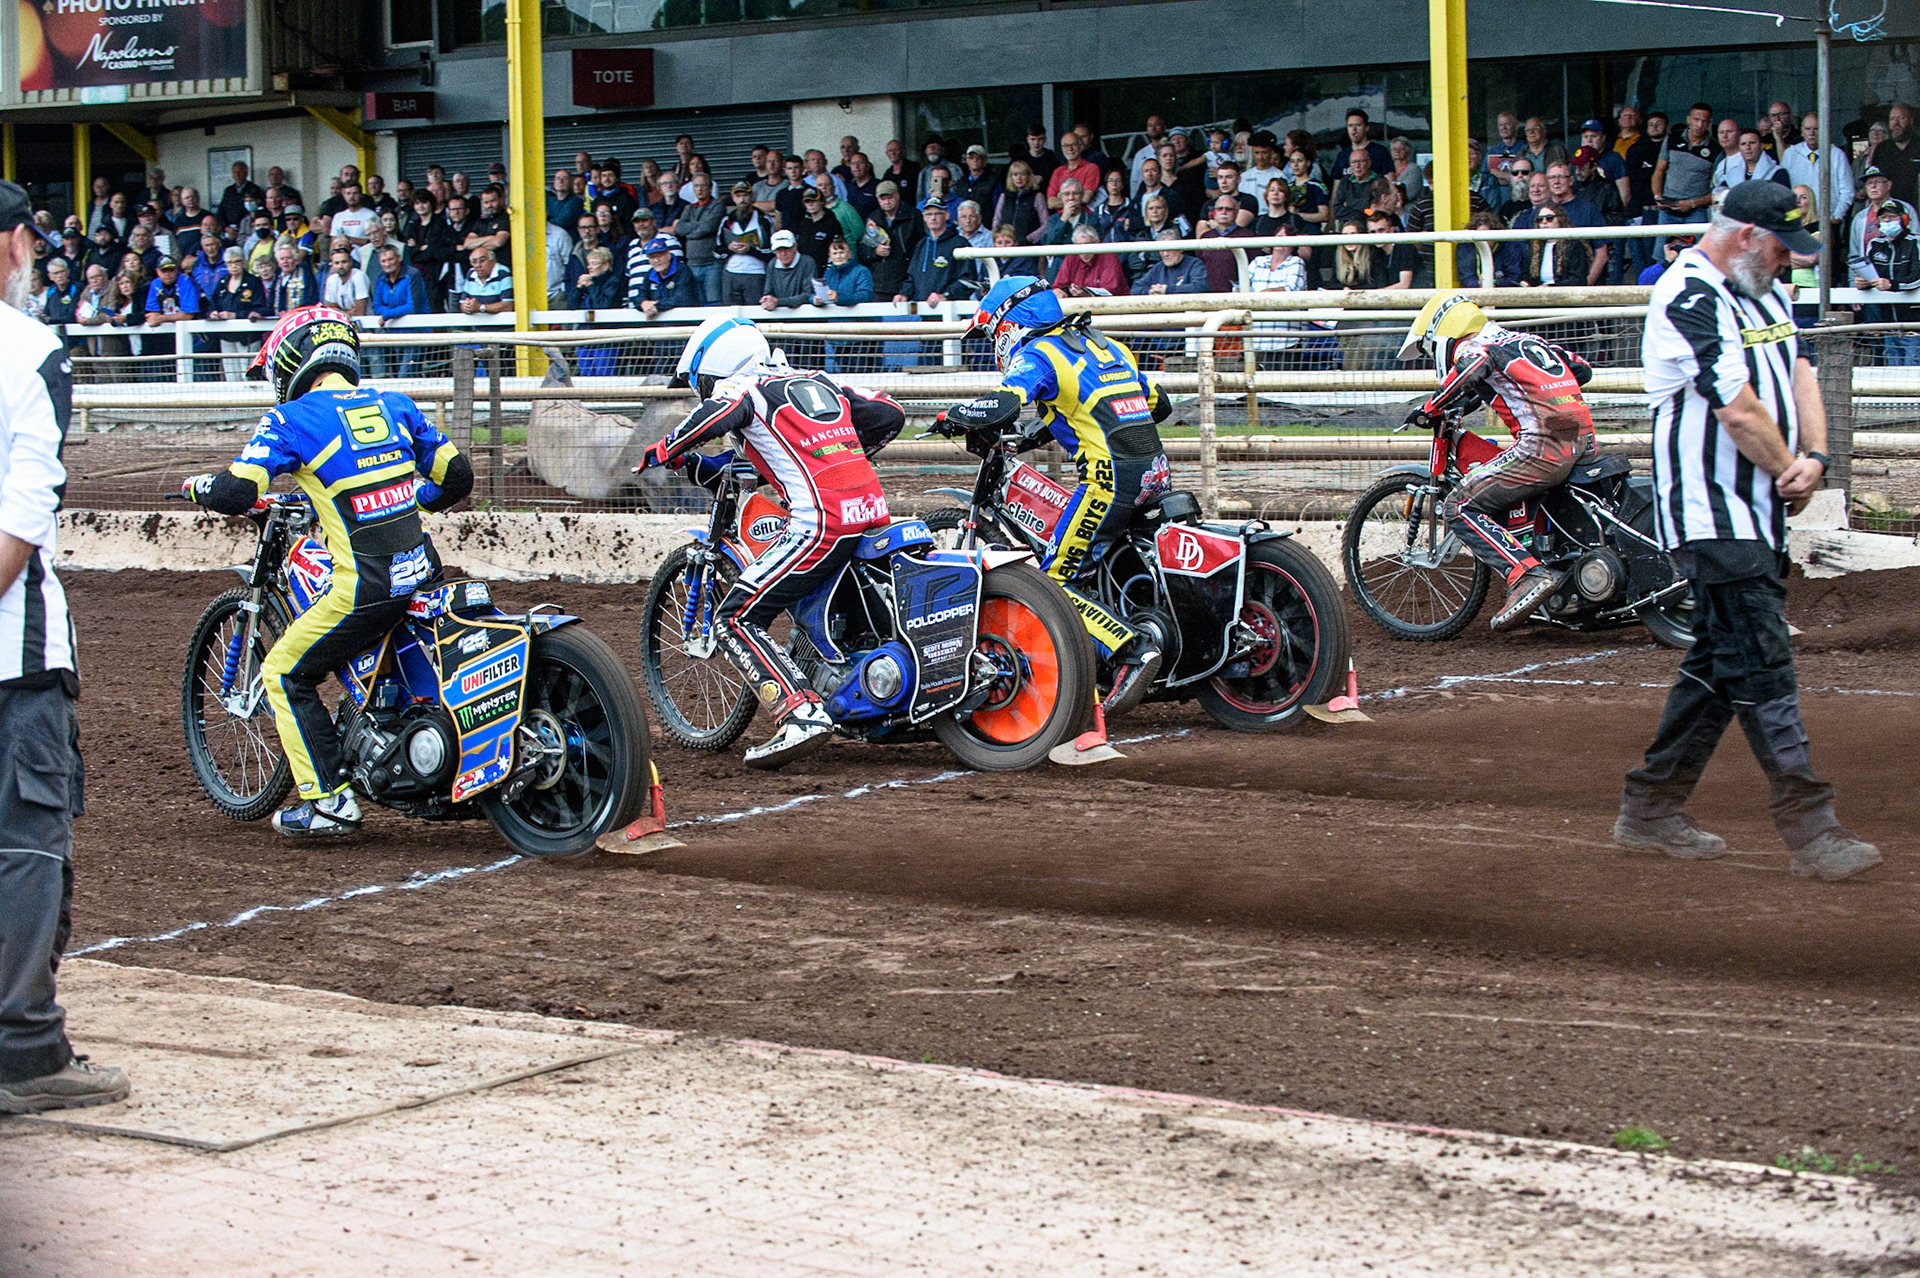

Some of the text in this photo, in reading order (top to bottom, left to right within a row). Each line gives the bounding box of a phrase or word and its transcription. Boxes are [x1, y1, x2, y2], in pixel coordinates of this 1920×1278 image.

[98, 13, 164, 26] SPONSORED BY
[75, 30, 180, 70] Napoleons
[108, 60, 139, 70] CASINO
[593, 70, 634, 83] TOTE
[392, 99, 417, 112] BAR
[1431, 294, 1467, 329] SCO
[320, 322, 349, 333] JACK
[804, 385, 826, 412] 1
[344, 404, 391, 445] 5
[800, 426, 857, 448] MANCHEST
[356, 449, 403, 470] HOLDER
[1017, 473, 1040, 494] LEW'S
[1008, 501, 1046, 533] claire
[1075, 498, 1108, 540] BOYS
[1508, 500, 1526, 519] red
[390, 553, 431, 588] 25
[906, 603, 975, 630] POLCOPPER
[463, 656, 519, 692] UNIFILTER
[472, 690, 518, 715] MONSTER
[479, 701, 516, 721] ENERGY
